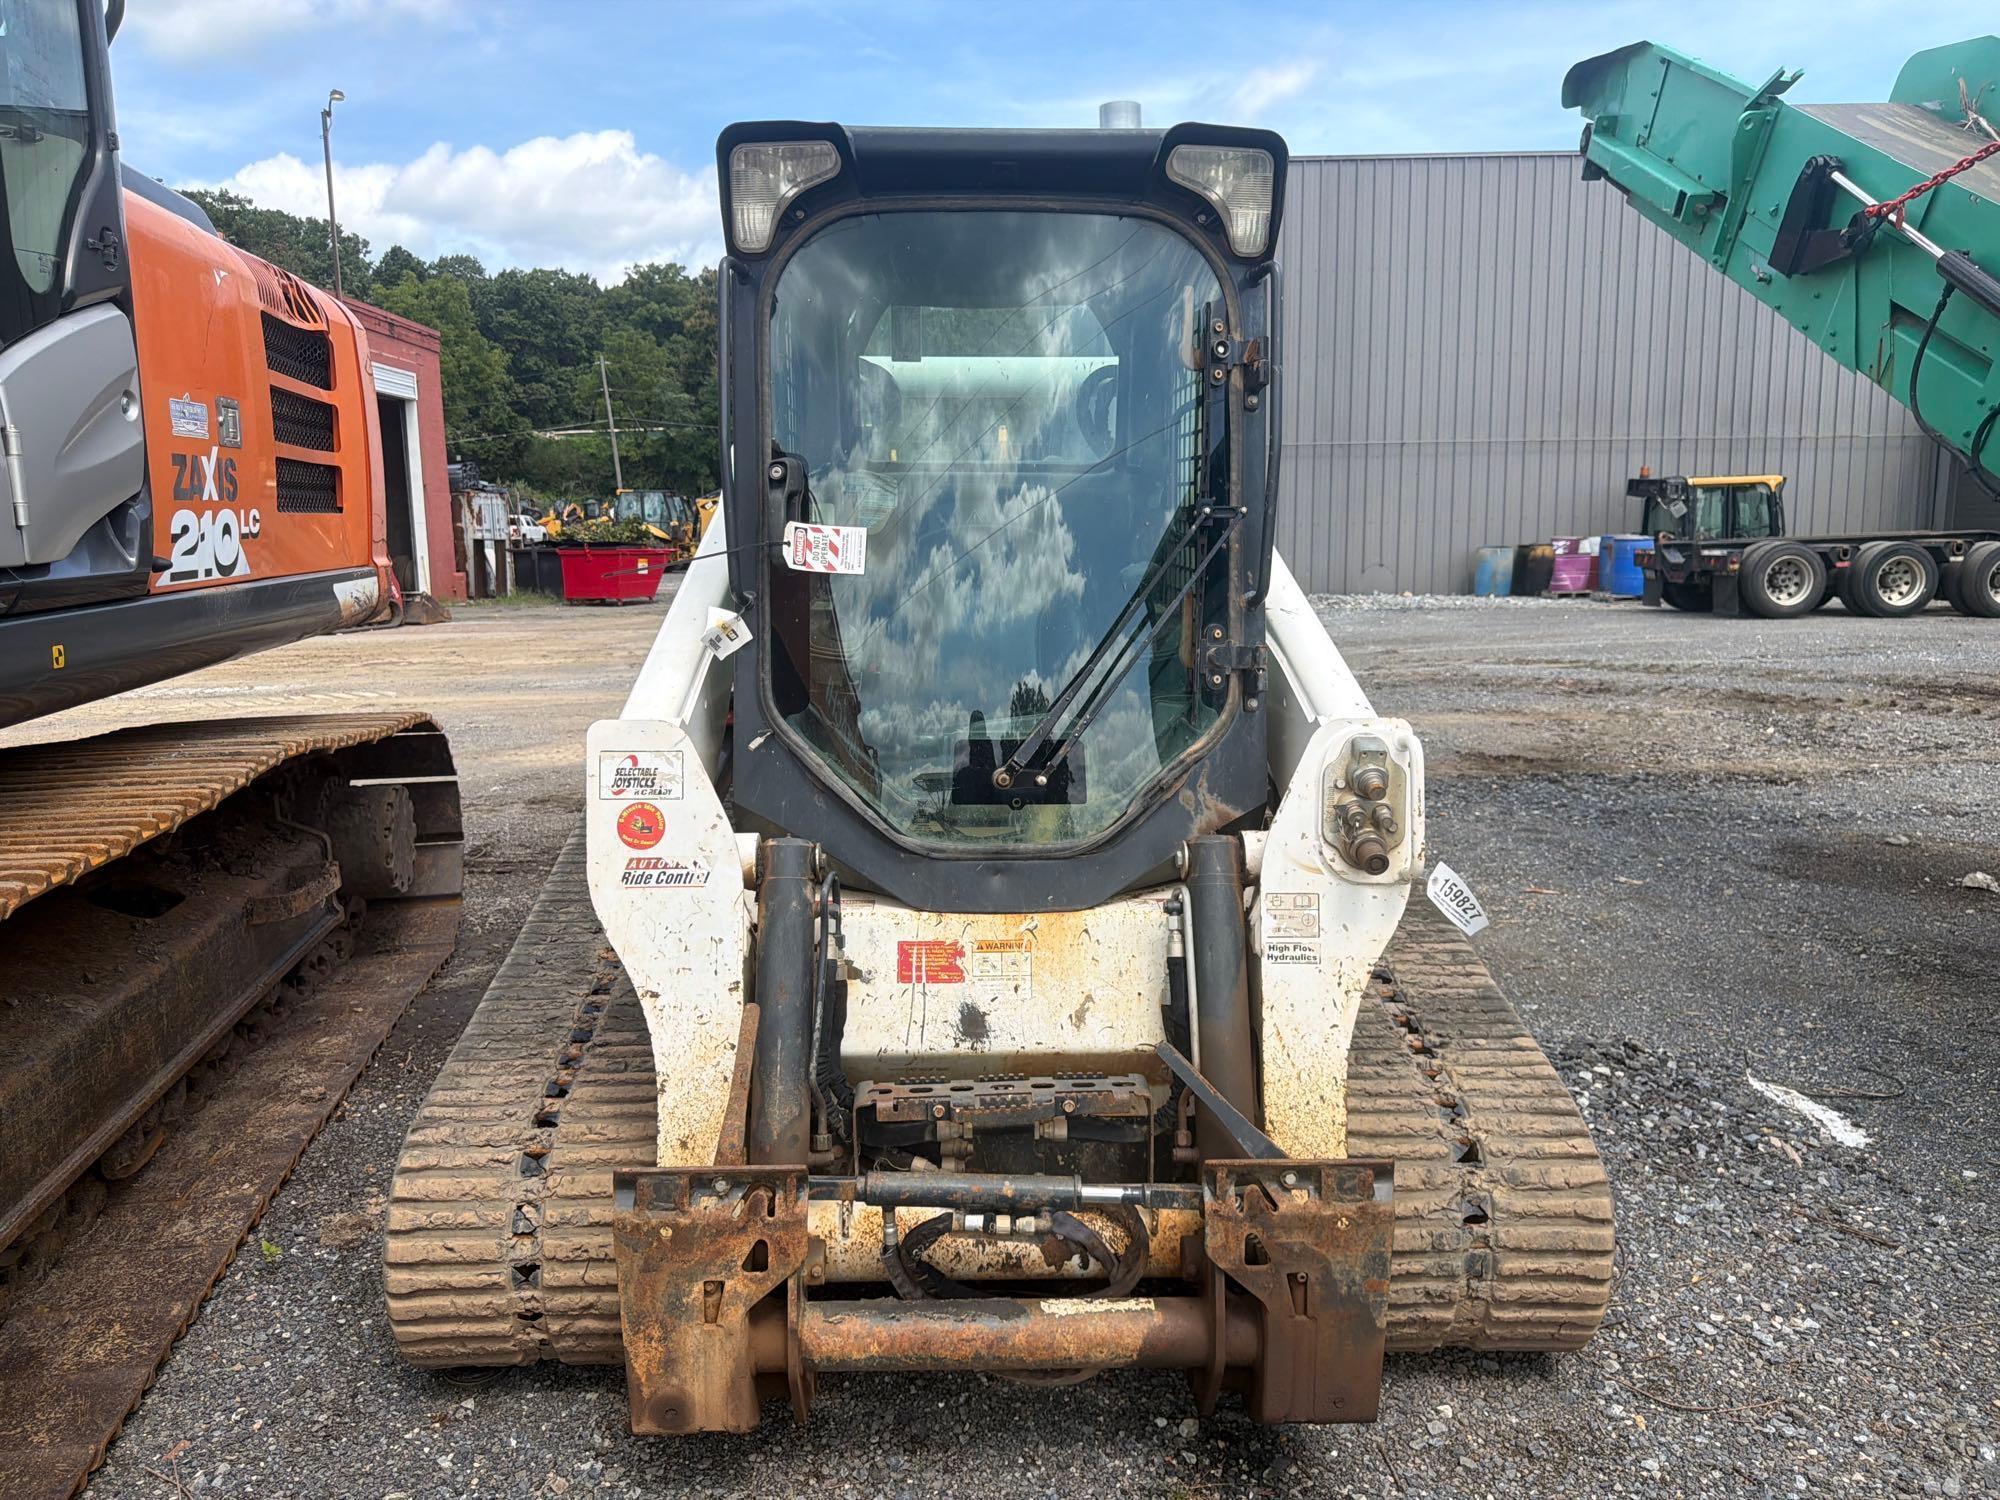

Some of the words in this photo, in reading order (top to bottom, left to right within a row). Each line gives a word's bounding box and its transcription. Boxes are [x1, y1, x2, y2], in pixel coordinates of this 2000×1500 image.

[171, 446, 239, 502] ZAXIS
[170, 508, 240, 582] 210
[240, 508, 260, 540] LC
[795, 530, 805, 563] DANGER
[821, 534, 829, 565] OPERATE
[813, 550, 820, 561] DO
[615, 767, 658, 777] SELECTABLE
[611, 777, 657, 788] JOYSTICKS
[621, 871, 653, 885] Ride
[1439, 877, 1482, 920] 159827
[1268, 945, 1290, 953] High
[1267, 953, 1318, 962] Hydraulics
